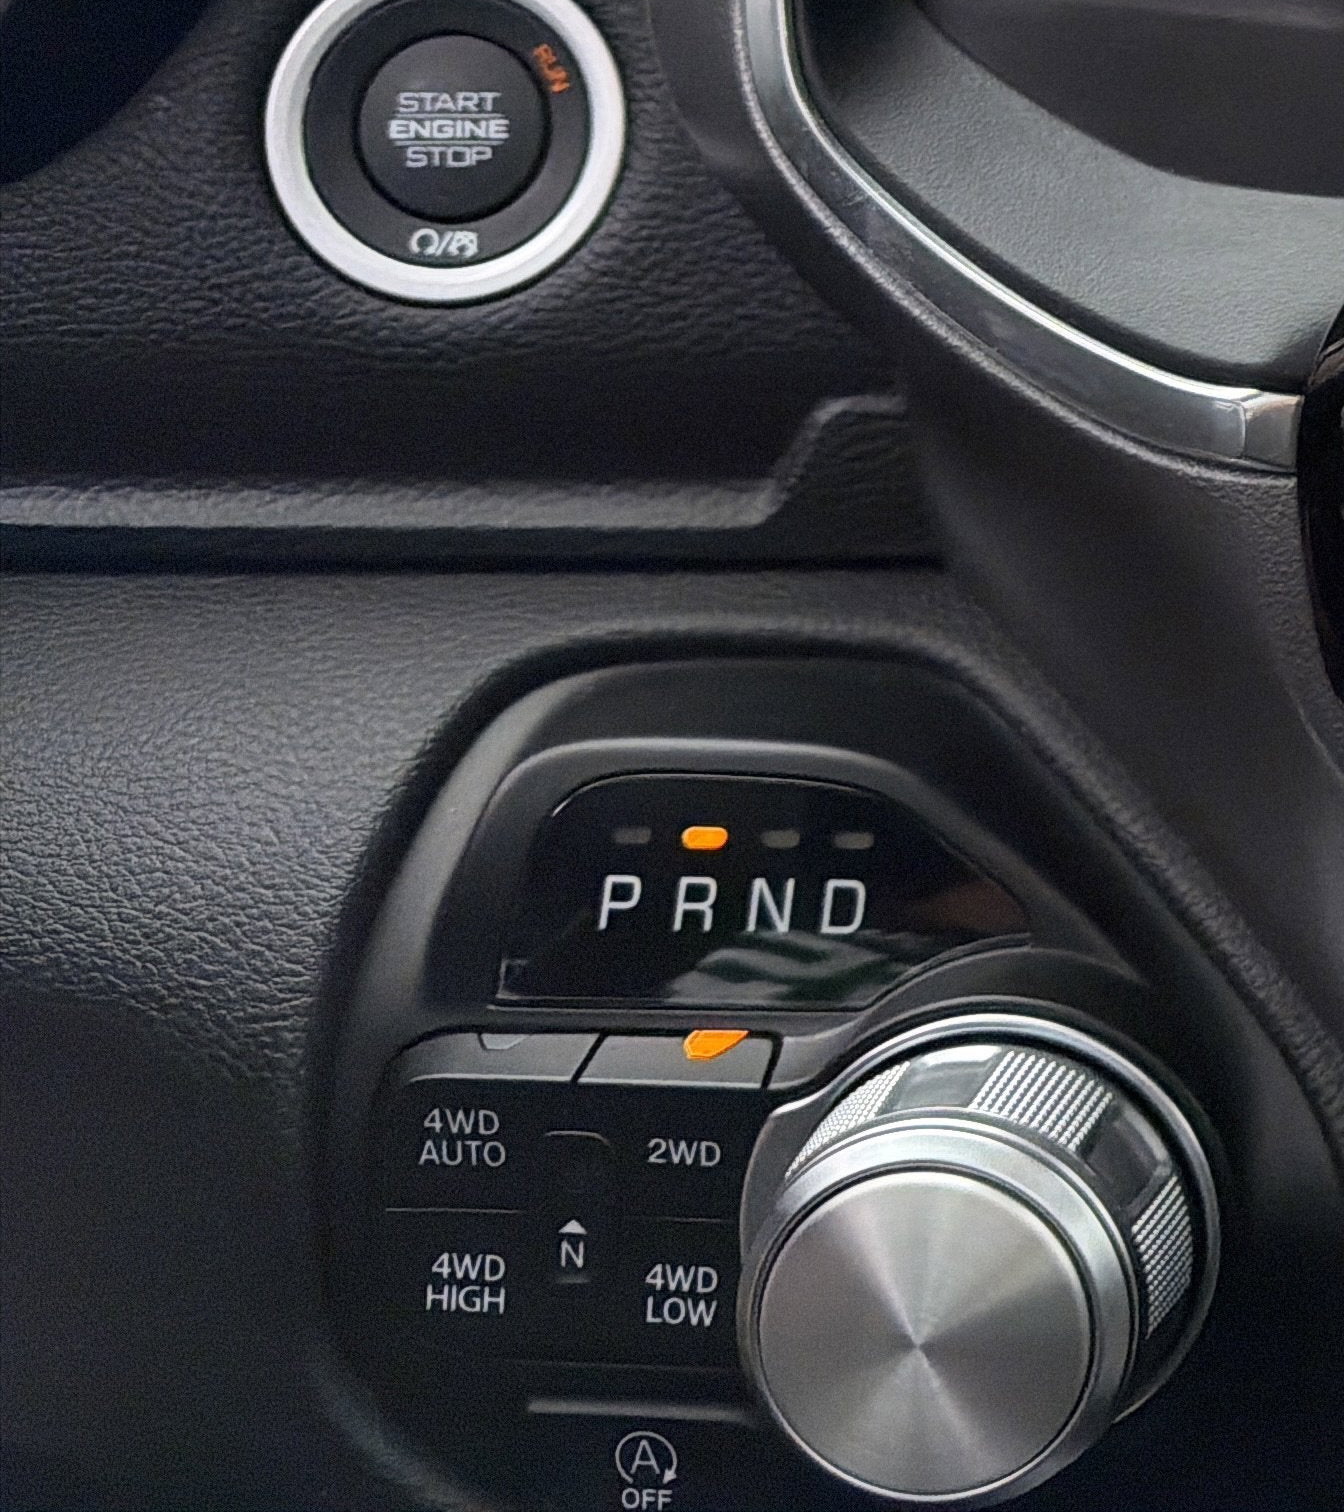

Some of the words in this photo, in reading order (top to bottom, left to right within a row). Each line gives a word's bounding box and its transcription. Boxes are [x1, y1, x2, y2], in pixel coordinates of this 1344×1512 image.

[397, 91, 502, 113] START
[388, 118, 511, 140] ENGINE
[404, 145, 494, 168] STOP
[598, 874, 642, 930] P
[672, 875, 718, 932] R
[746, 877, 795, 933] N
[819, 878, 866, 935] D
[423, 1108, 500, 1135] 4WD
[418, 1138, 506, 1167] AUTO
[647, 1137, 721, 1167] 2WD
[431, 1252, 506, 1282] 4WD
[560, 1240, 585, 1268] N
[645, 1263, 718, 1294] 4WD
[426, 1283, 506, 1314] HIGH
[646, 1295, 717, 1327] LOW
[629, 1438, 661, 1475] A
[621, 1487, 673, 1511] OFF
